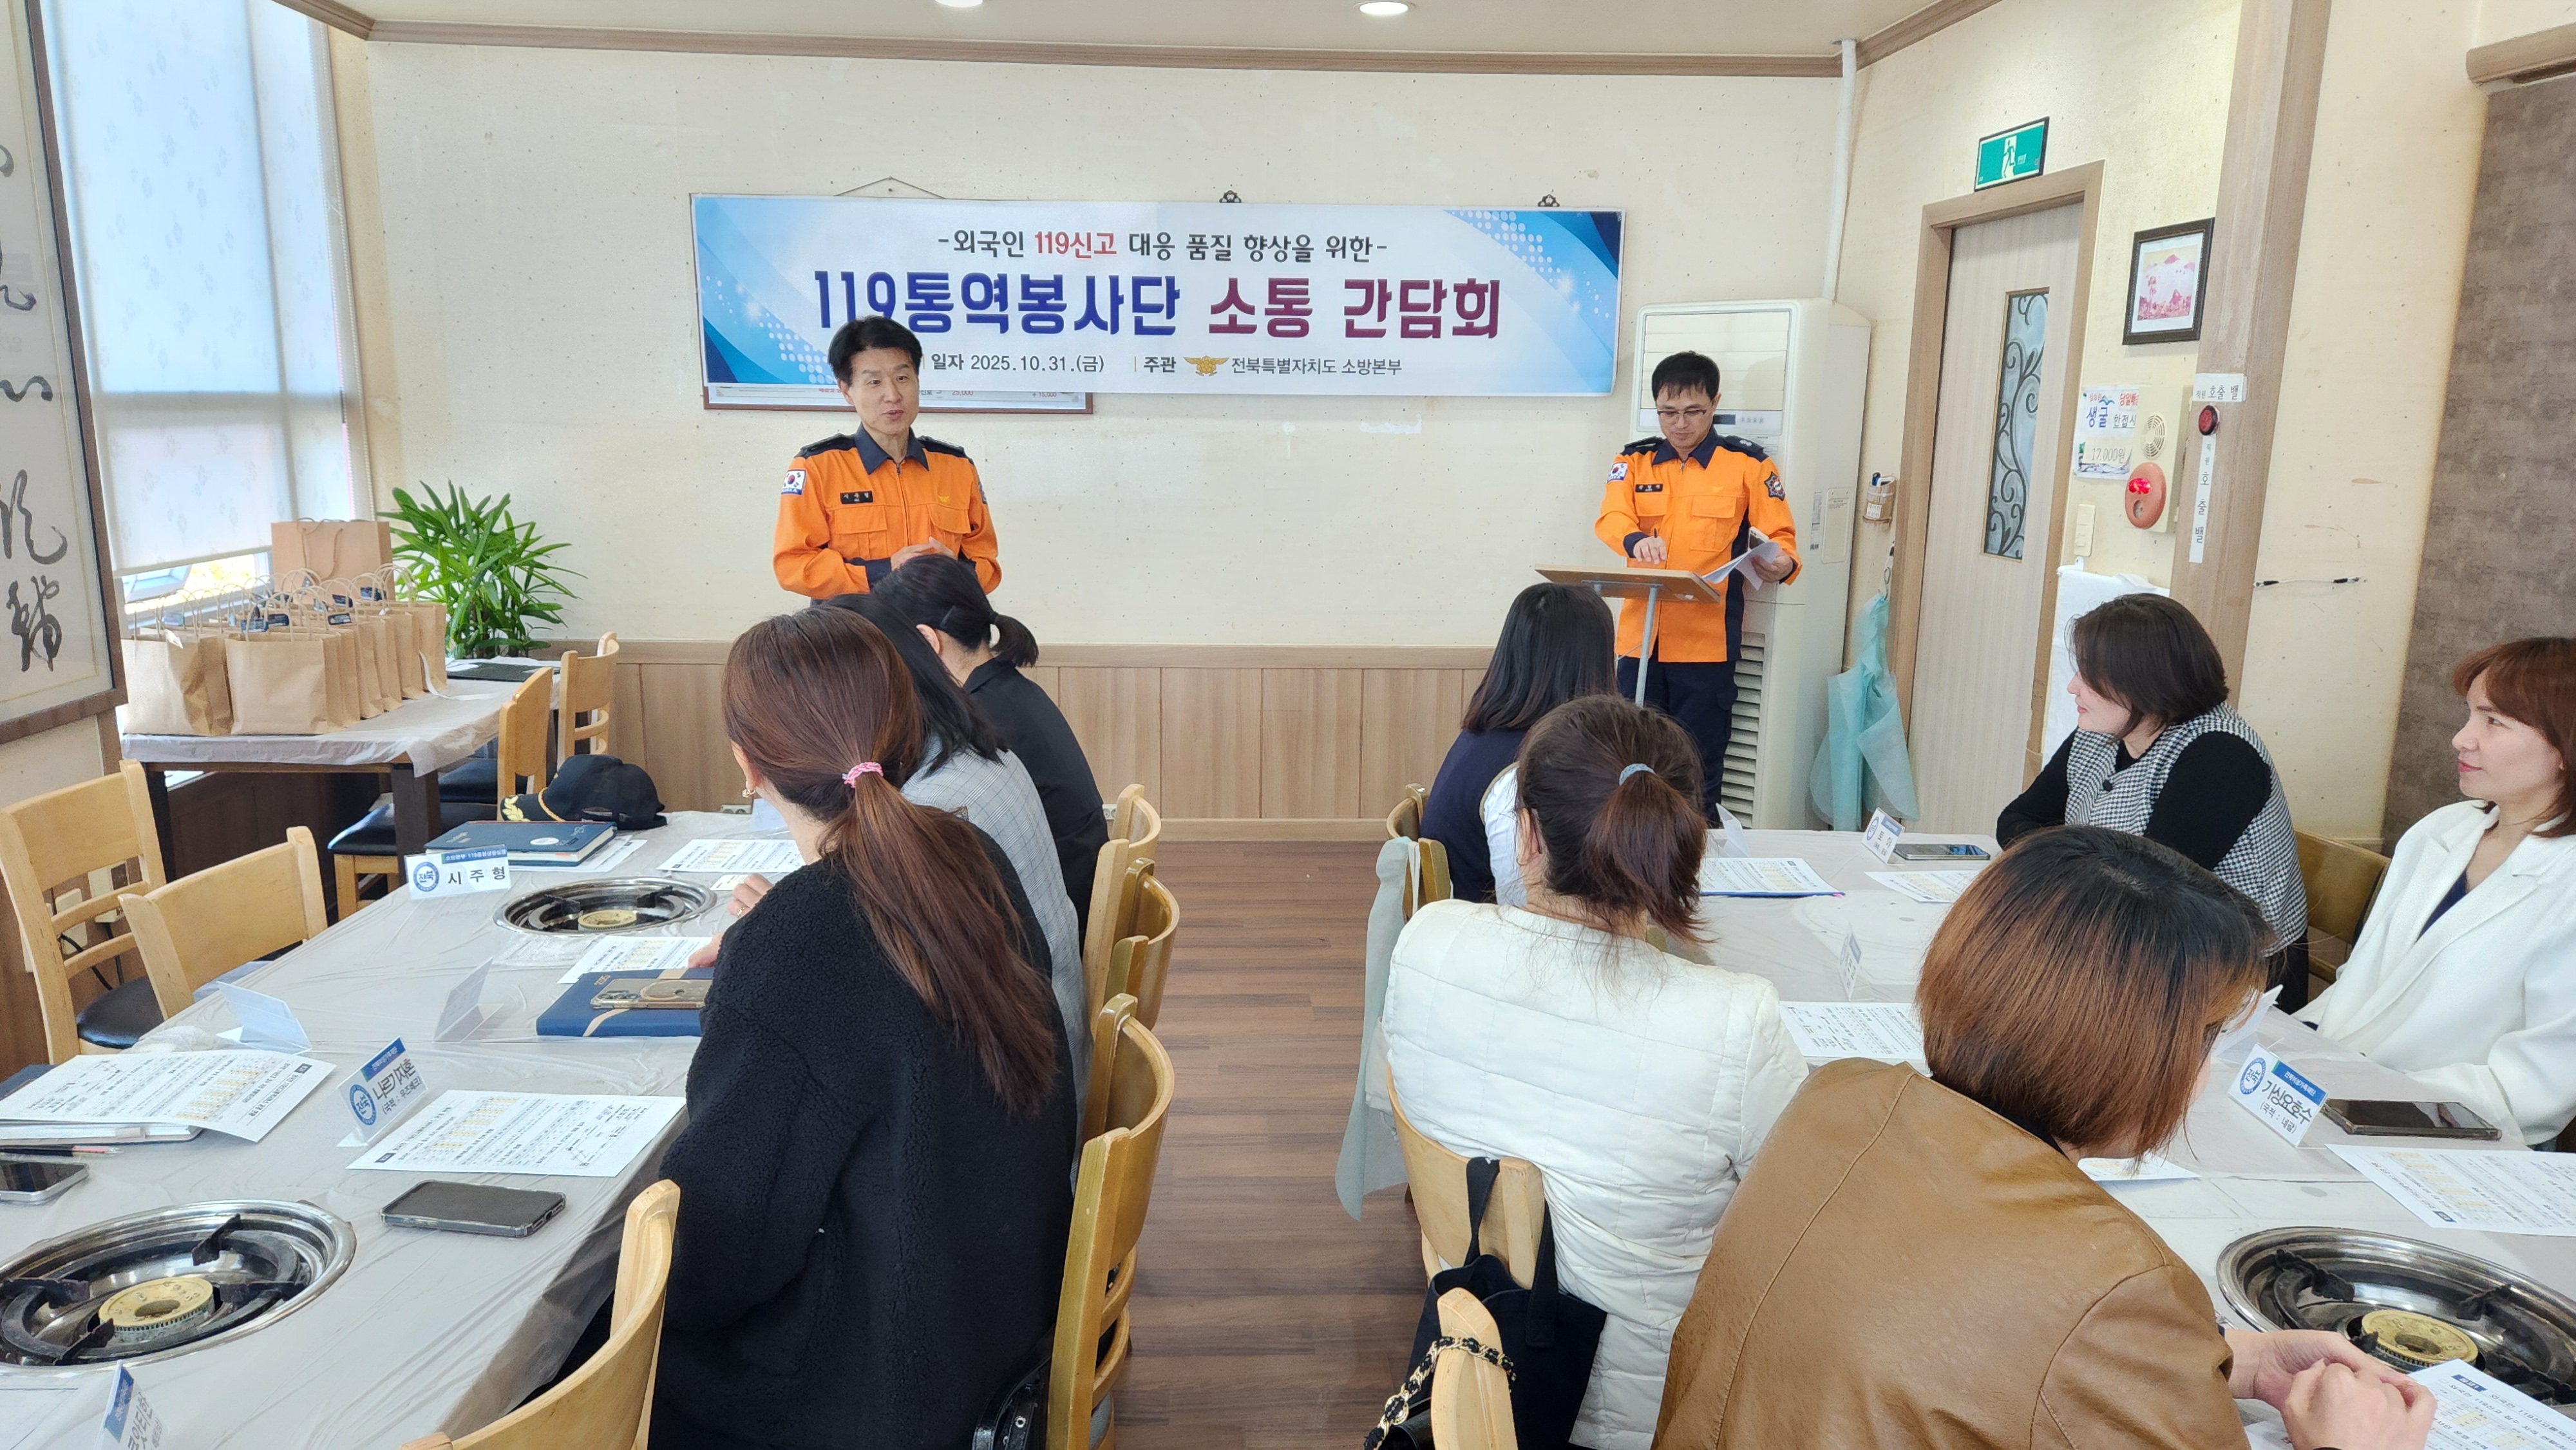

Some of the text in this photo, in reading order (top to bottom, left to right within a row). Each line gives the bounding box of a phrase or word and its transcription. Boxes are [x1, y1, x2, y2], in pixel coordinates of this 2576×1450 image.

[1034, 231, 1117, 257] 119신고
[1129, 232, 1176, 260] 대응
[1186, 234, 1233, 261] 품질
[1244, 234, 1315, 263] 향상을
[815, 270, 1501, 339] 119통역봉사단 소통 간담회
[932, 353, 1104, 373] 일자 2025.10.31.(금)
[1143, 357, 1403, 376] 주관 전북특별자치도 소방본부
